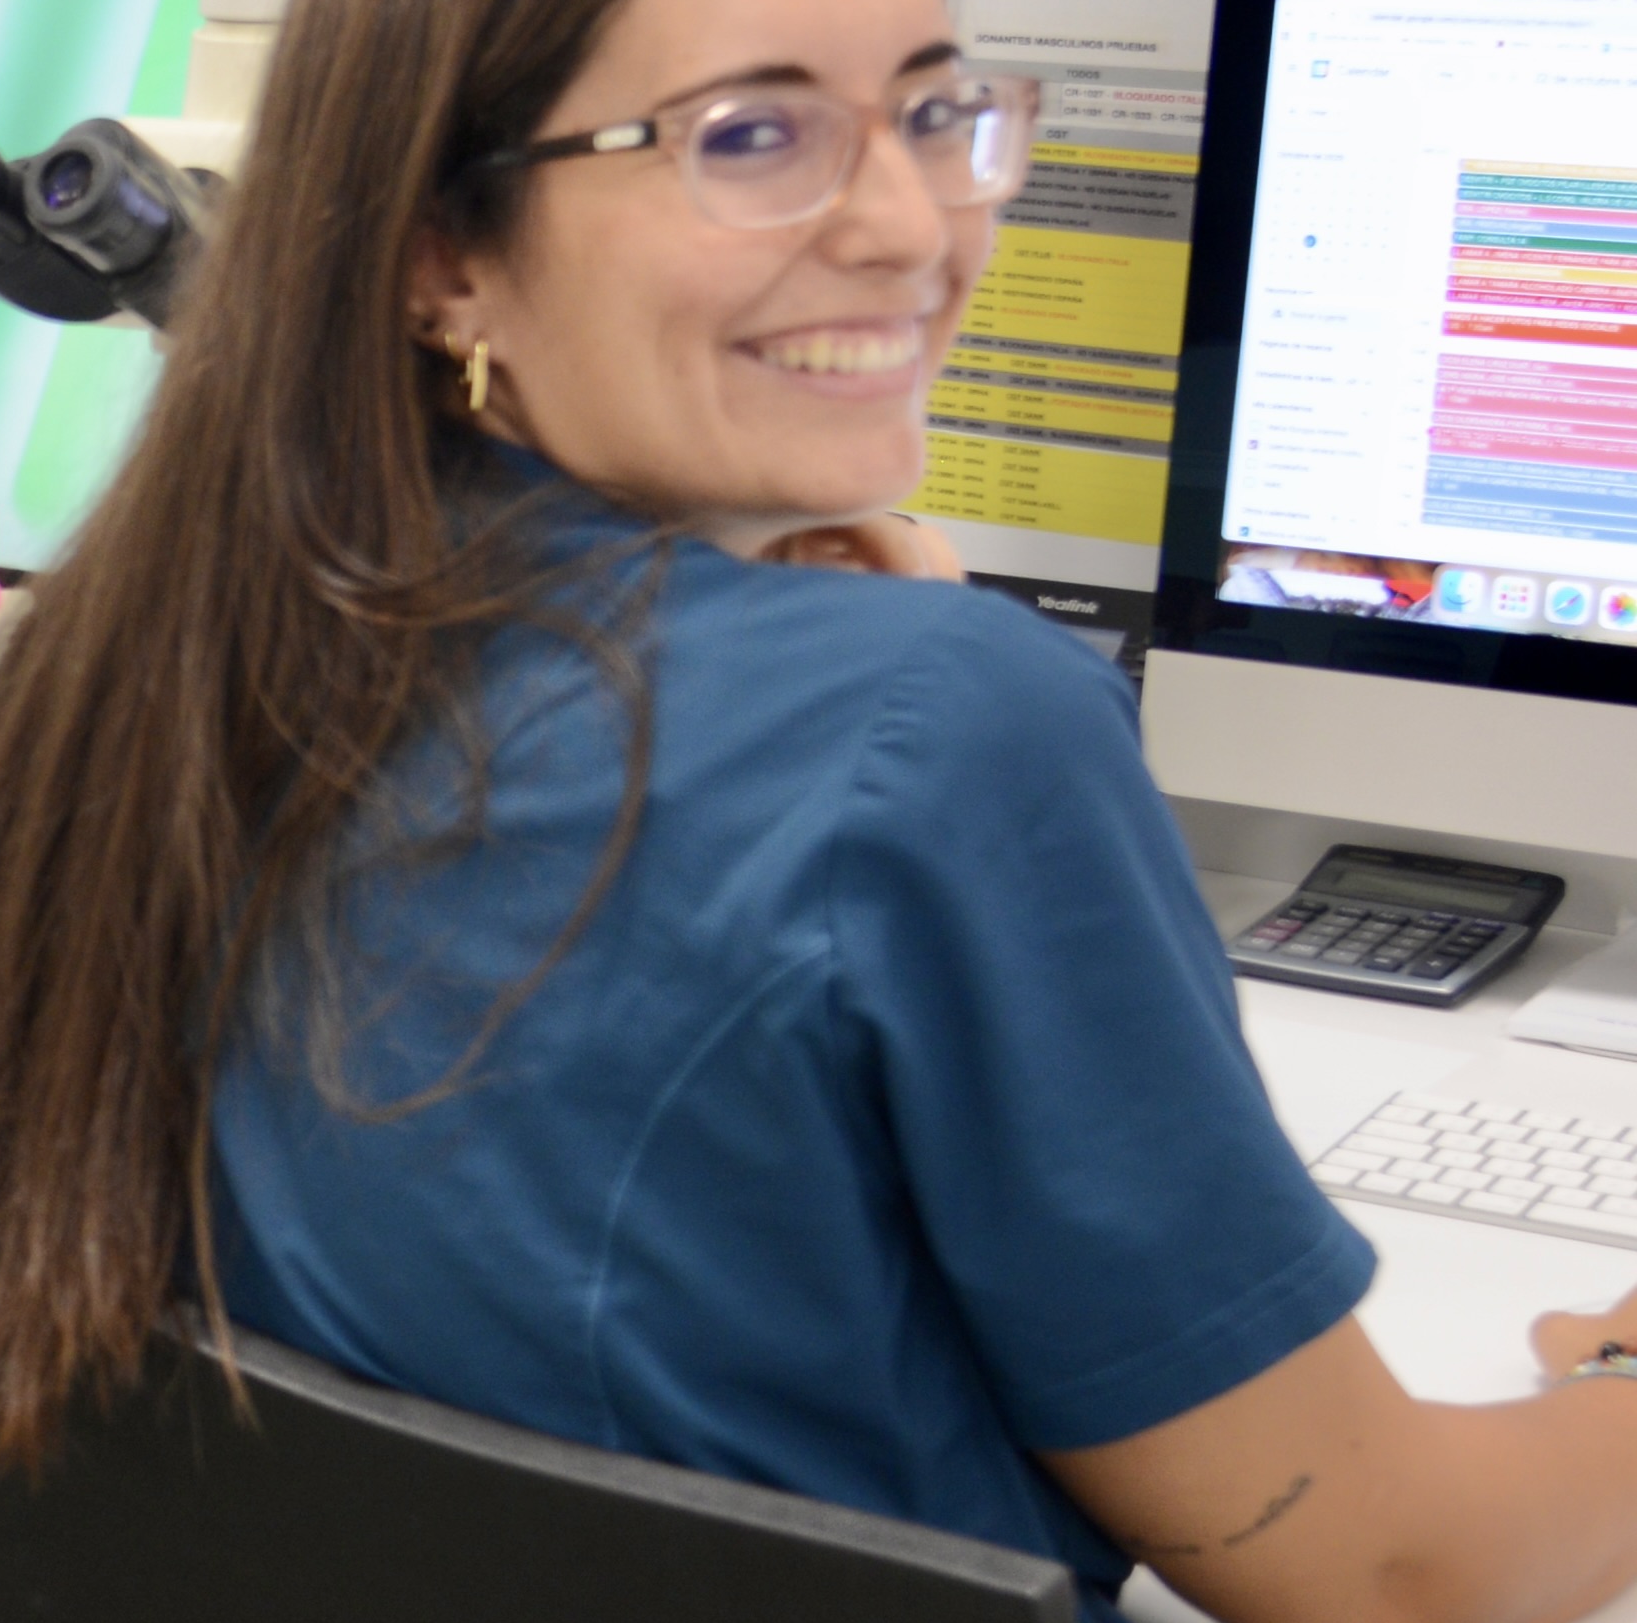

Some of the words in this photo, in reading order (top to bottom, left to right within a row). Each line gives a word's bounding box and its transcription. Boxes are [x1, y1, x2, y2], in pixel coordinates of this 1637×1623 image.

[976, 35, 1031, 45] DONANTES
[1034, 38, 1103, 49] MASCULINOS
[1106, 41, 1157, 52] PRUEBAS
[1066, 70, 1100, 79] TODOS
[1046, 130, 1068, 139] CGT
[1037, 596, 1100, 614] Yealink
